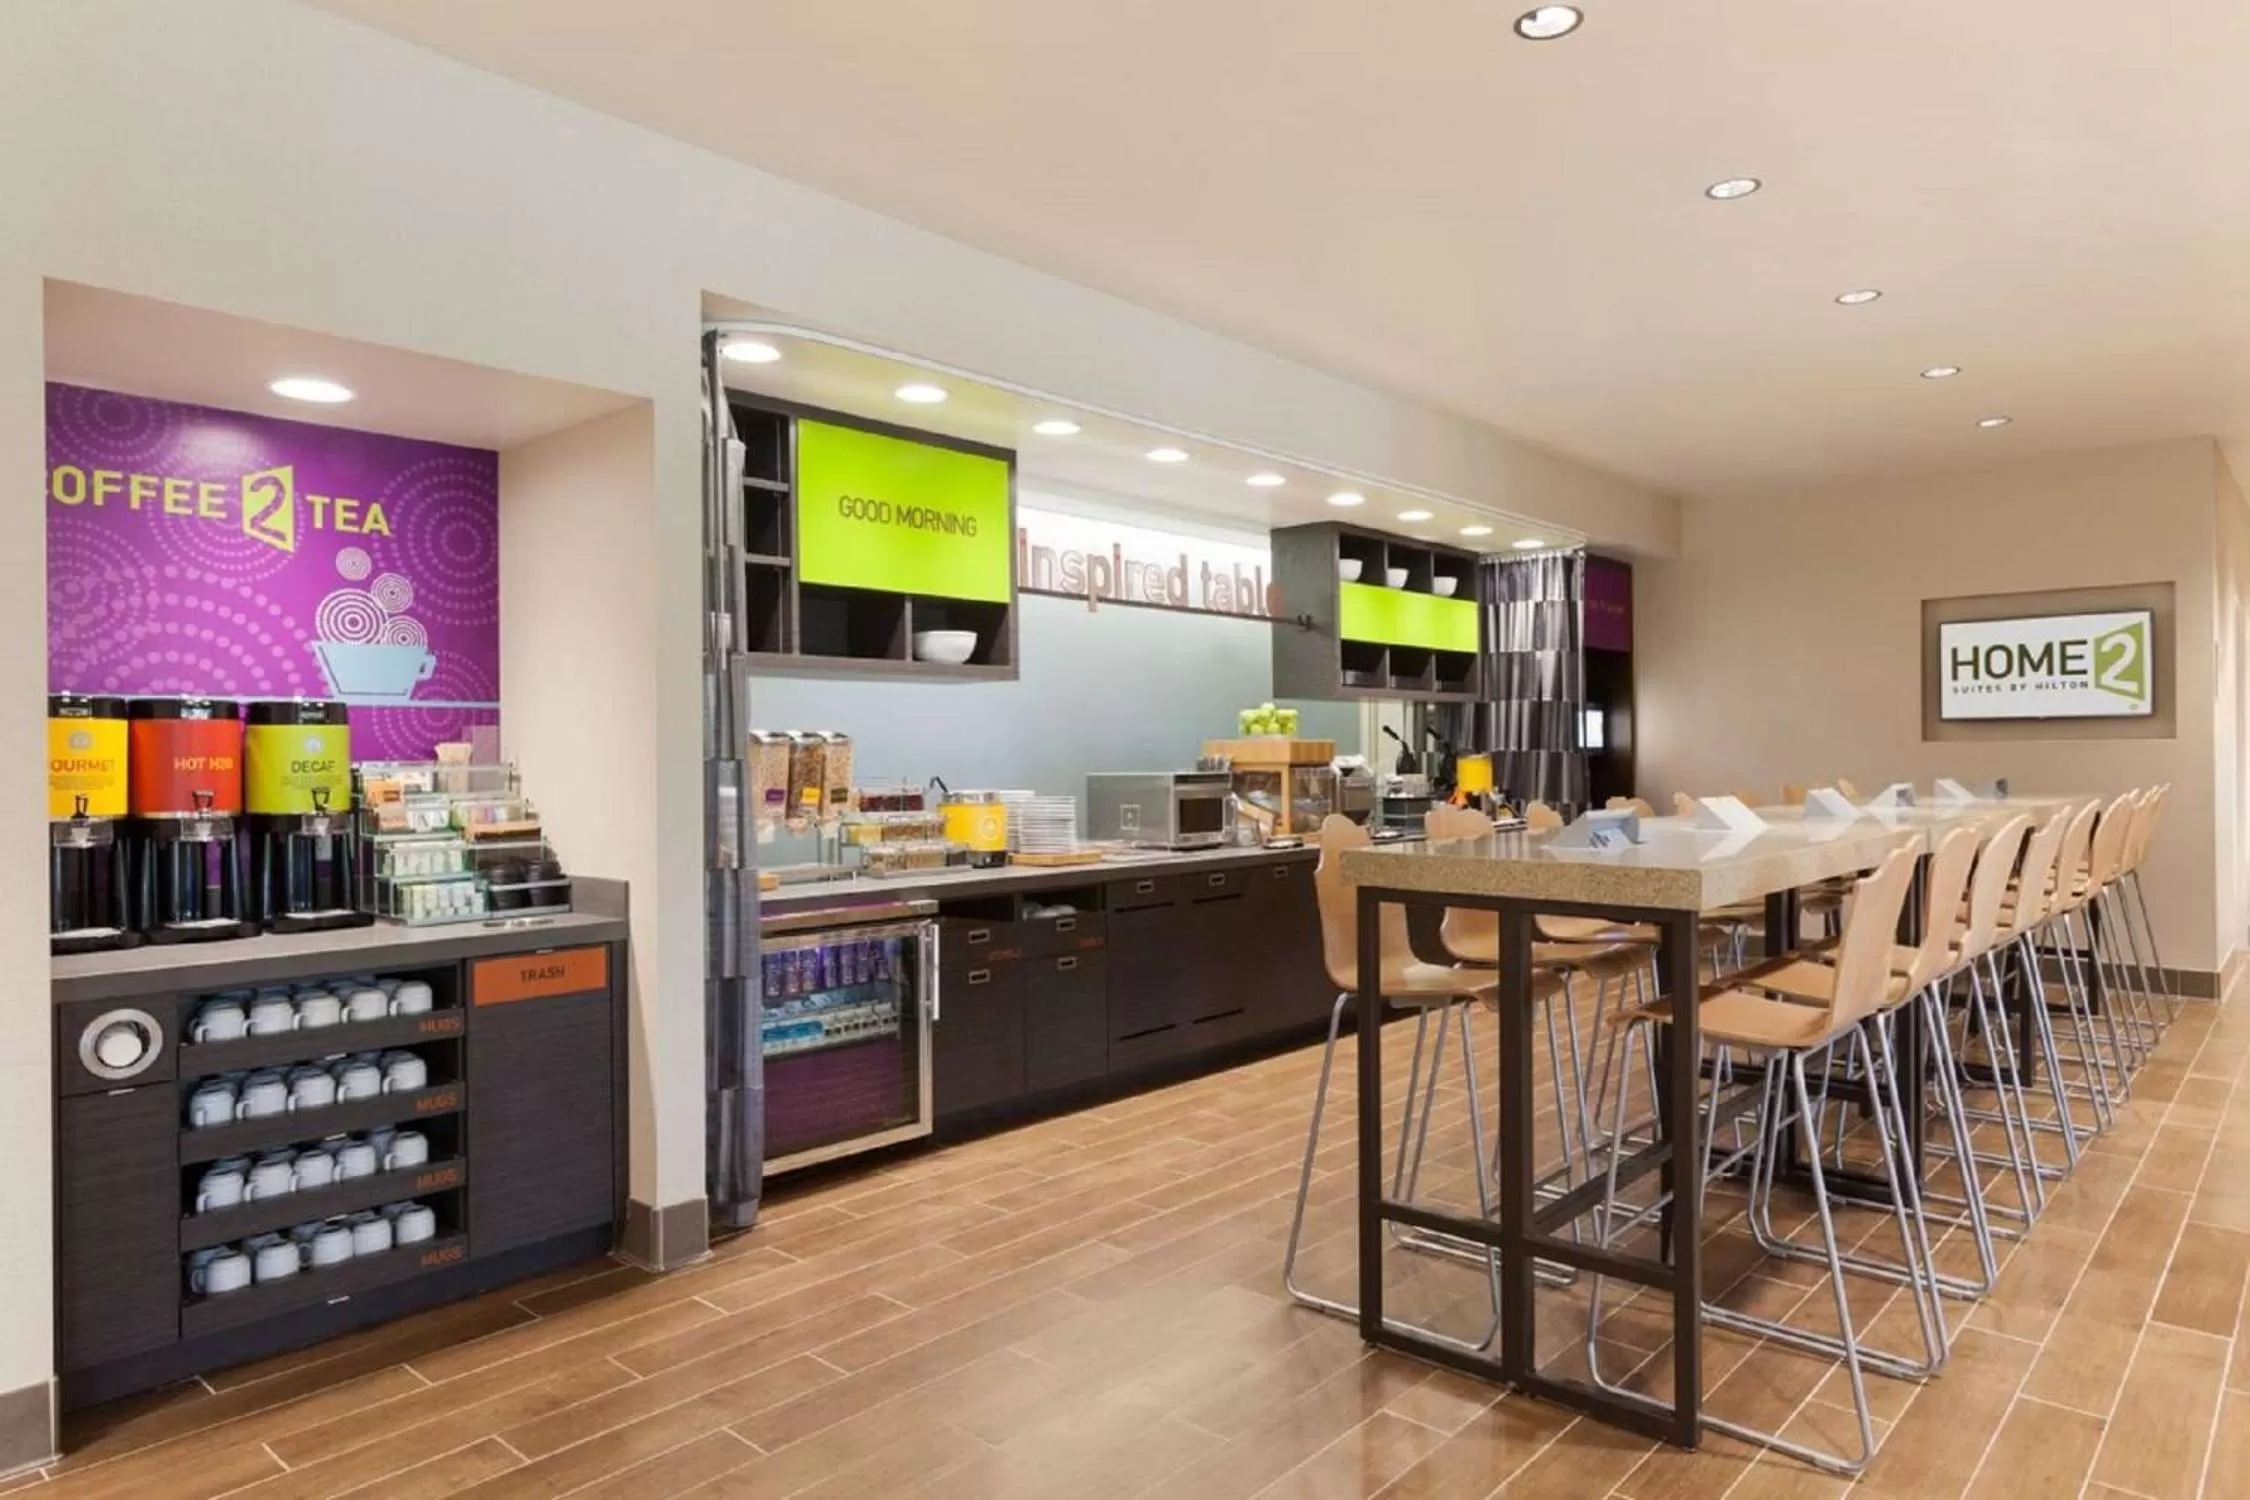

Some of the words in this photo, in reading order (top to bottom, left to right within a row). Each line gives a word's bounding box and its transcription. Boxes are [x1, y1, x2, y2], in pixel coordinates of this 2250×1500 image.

[51, 465, 227, 518] OFFEE
[248, 474, 289, 541] 2
[306, 494, 393, 537] TEA
[838, 494, 891, 525] GOOD
[896, 503, 977, 537] MORNING
[1018, 527, 1189, 613] inspired
[1951, 639, 2089, 681] HOME
[2100, 631, 2139, 694] 2
[1953, 684, 2003, 694] SUITES
[2010, 683, 2028, 692] BY
[2035, 681, 2089, 690] HILTON
[48, 758, 115, 773] OURMET
[173, 756, 206, 771] HOT
[291, 760, 336, 774] DECAF
[520, 966, 566, 983] TRASH
[419, 1016, 461, 1033] MUGS
[415, 1091, 457, 1112] MUGS
[416, 1168, 457, 1190] MUGS
[421, 1246, 463, 1267] MUGS
